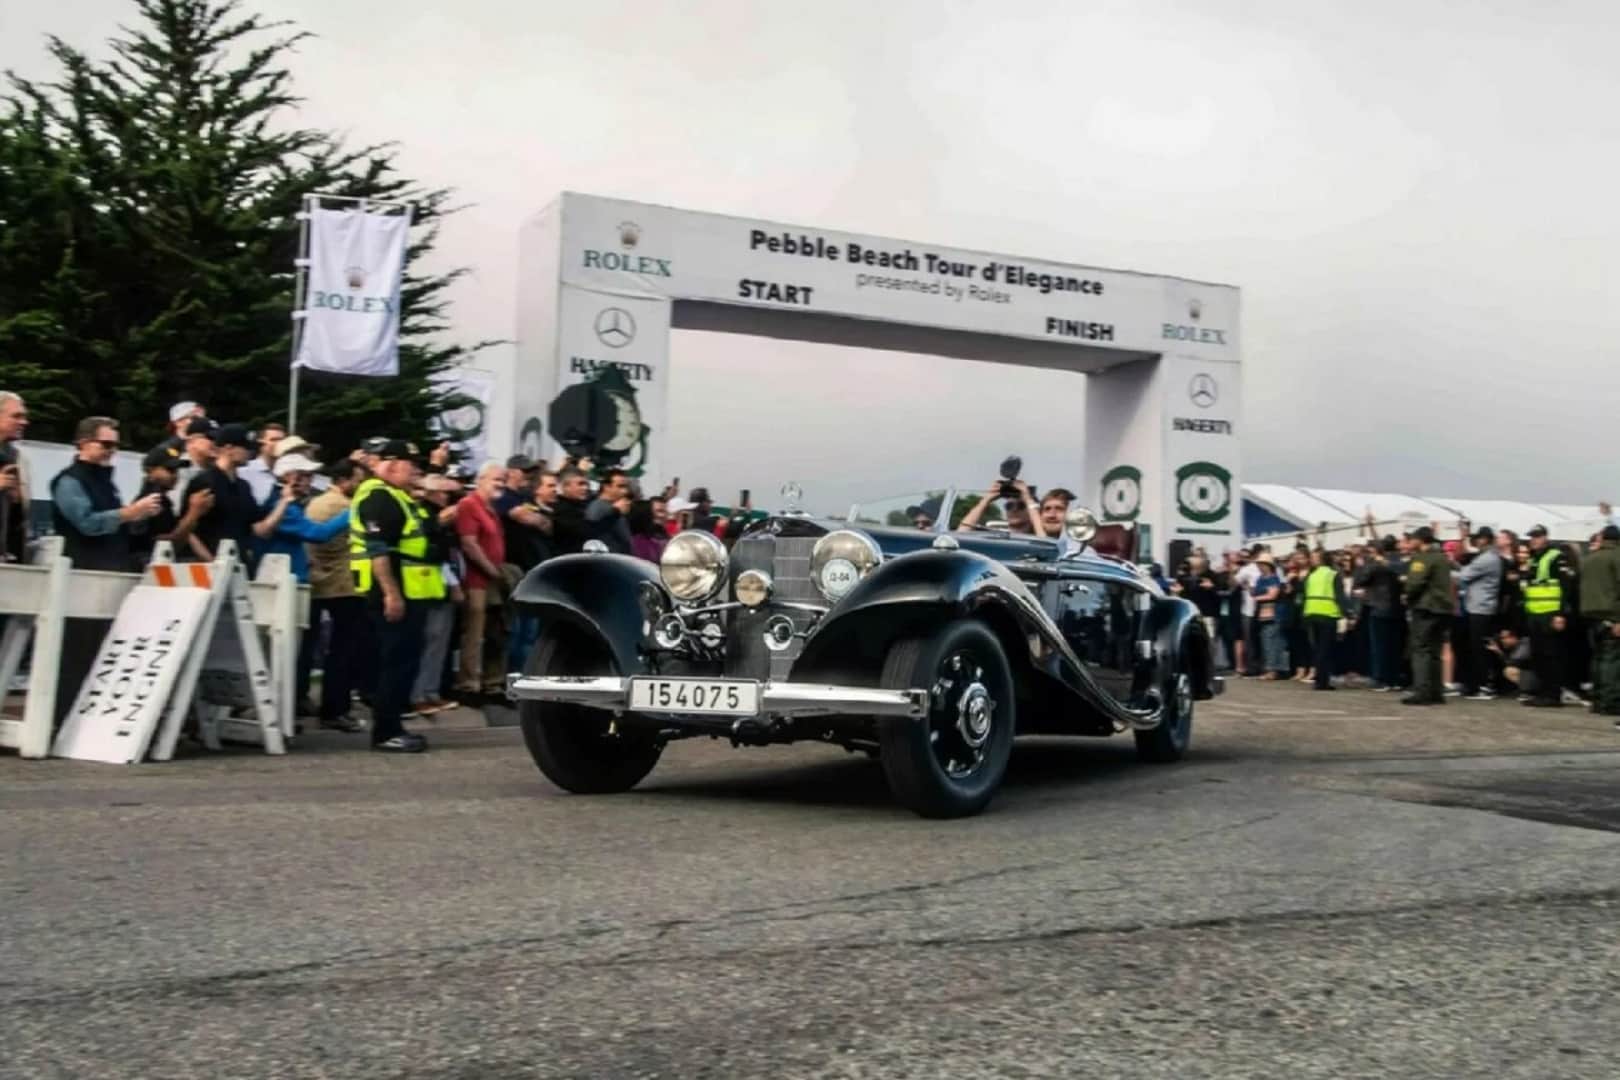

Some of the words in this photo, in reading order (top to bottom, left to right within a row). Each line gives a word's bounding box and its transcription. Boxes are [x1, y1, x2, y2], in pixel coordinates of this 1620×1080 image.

[583, 249, 673, 277] ROLEX
[750, 230, 839, 260] Pebble
[846, 243, 919, 271] Beach
[924, 253, 978, 278] Tour
[982, 261, 1105, 296] d'Elegance
[313, 290, 396, 313] ROLEX
[738, 278, 814, 305] START
[855, 272, 940, 296] presented
[945, 284, 964, 302] by
[968, 284, 1012, 304] Rolex
[1045, 316, 1115, 341] FINISH
[1162, 322, 1228, 345] ROLEX
[1172, 416, 1233, 436] HAGERTY
[647, 682, 740, 710] 154075
